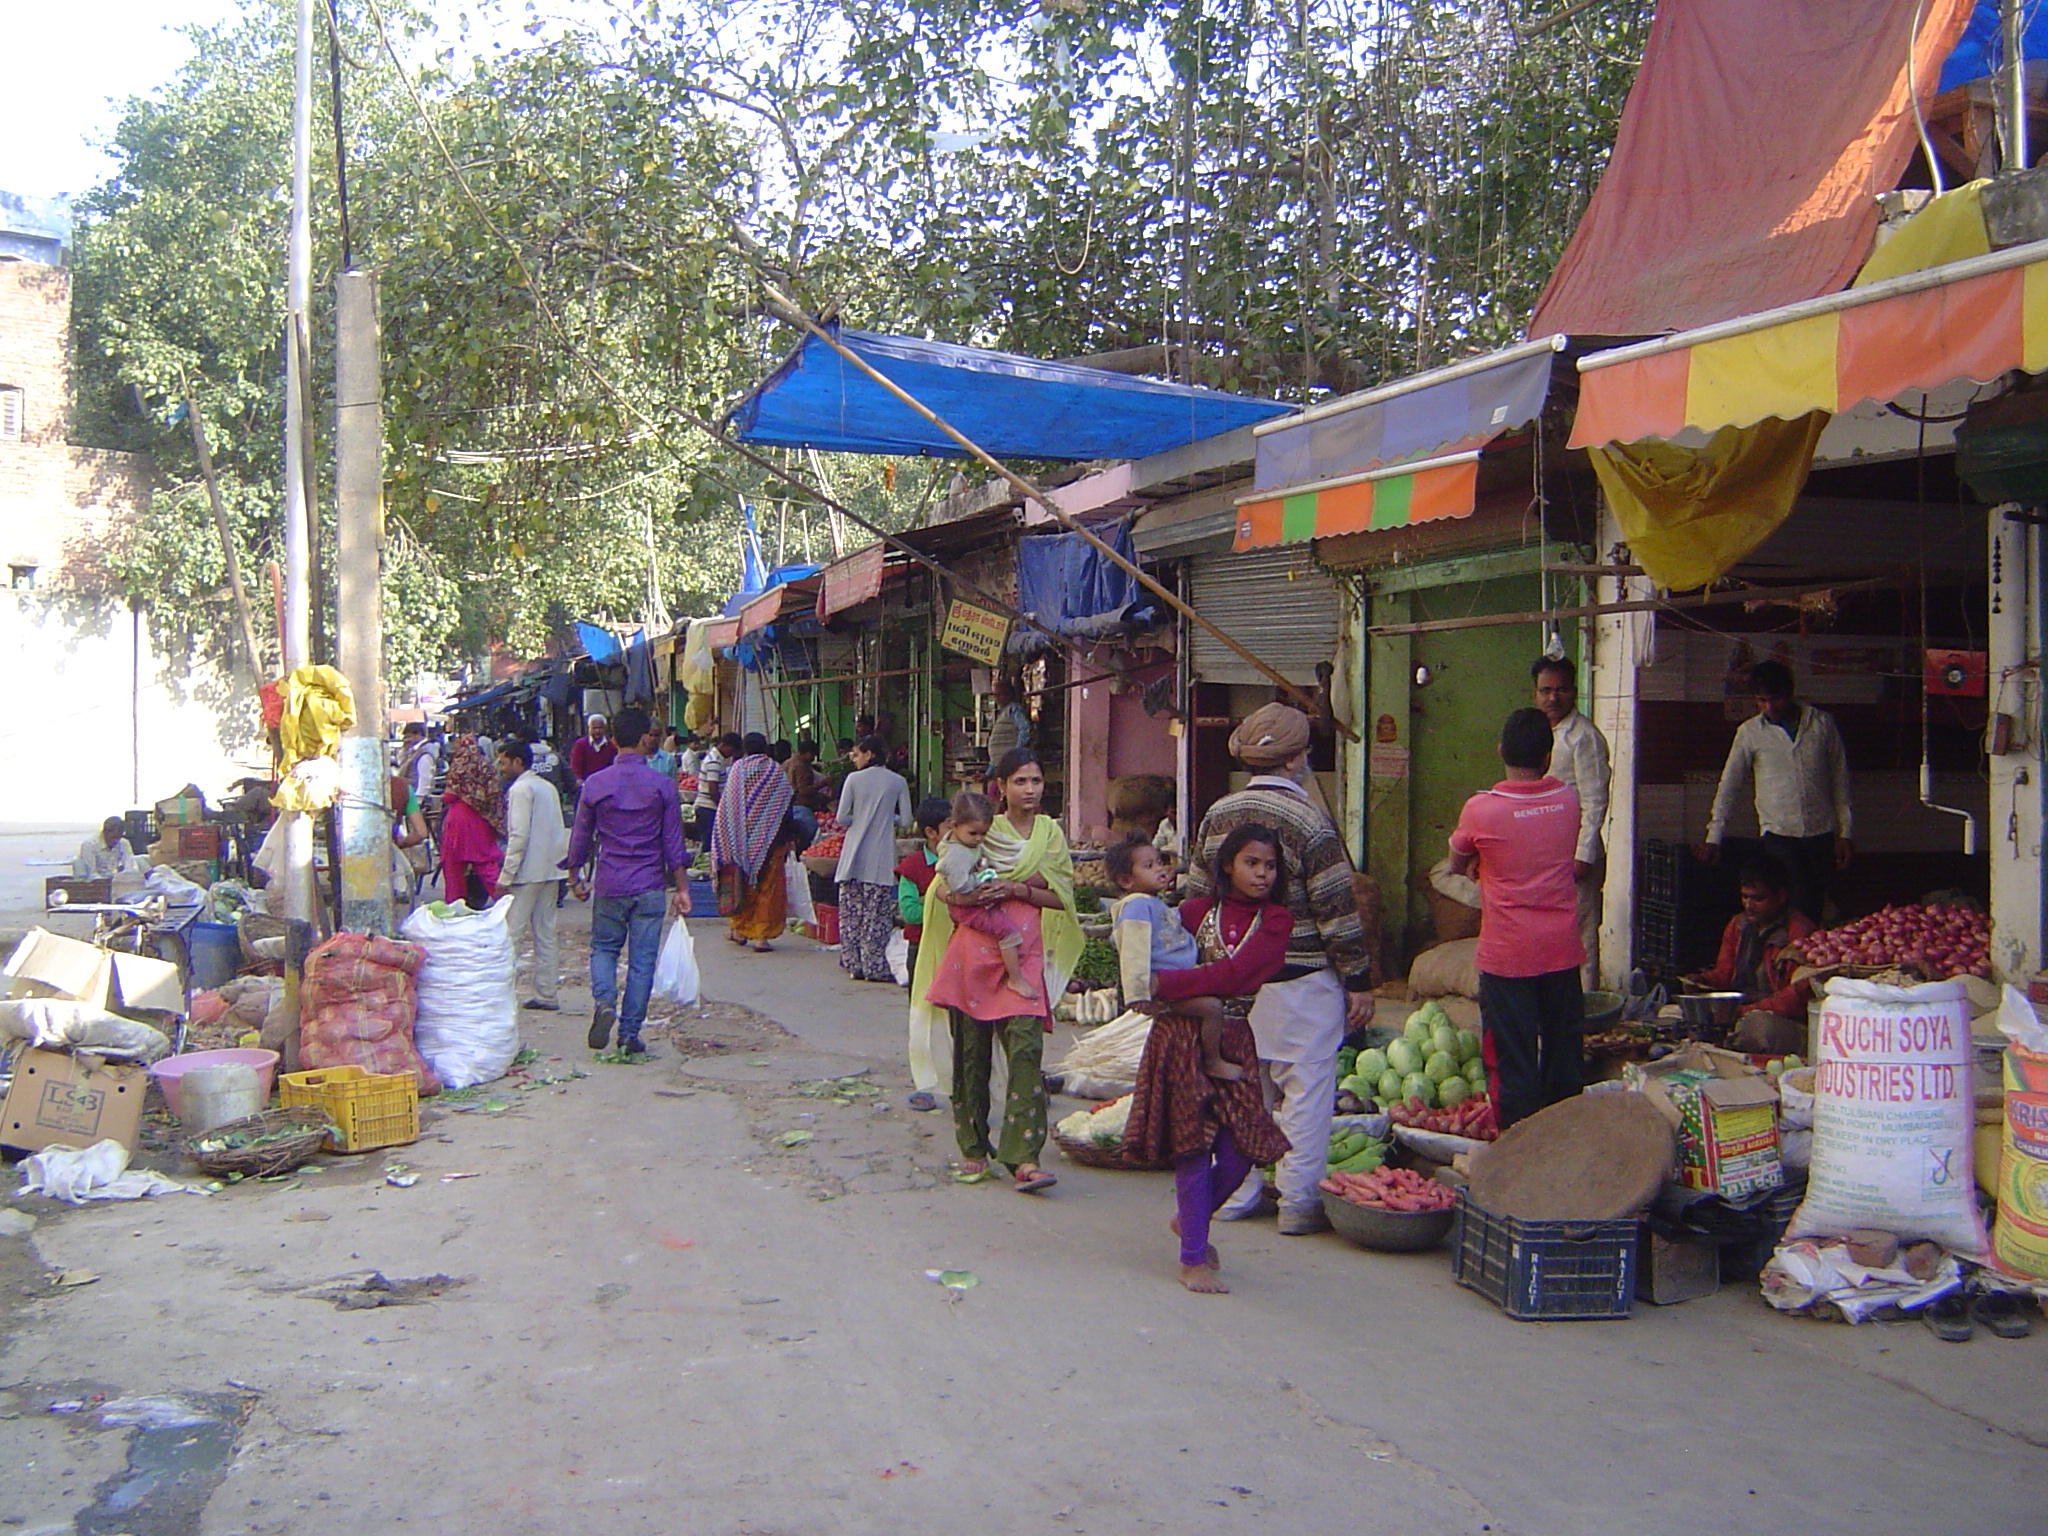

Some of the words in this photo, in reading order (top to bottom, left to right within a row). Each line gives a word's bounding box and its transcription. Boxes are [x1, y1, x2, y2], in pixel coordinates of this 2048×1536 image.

[1513, 803, 1564, 818] BENETTON
[1822, 1011, 1893, 1059] RUCHI
[1899, 1015, 1952, 1053] SOYA
[1818, 1058, 1914, 1102] NDUSTRIES
[1921, 1064, 1957, 1100] LTD.
